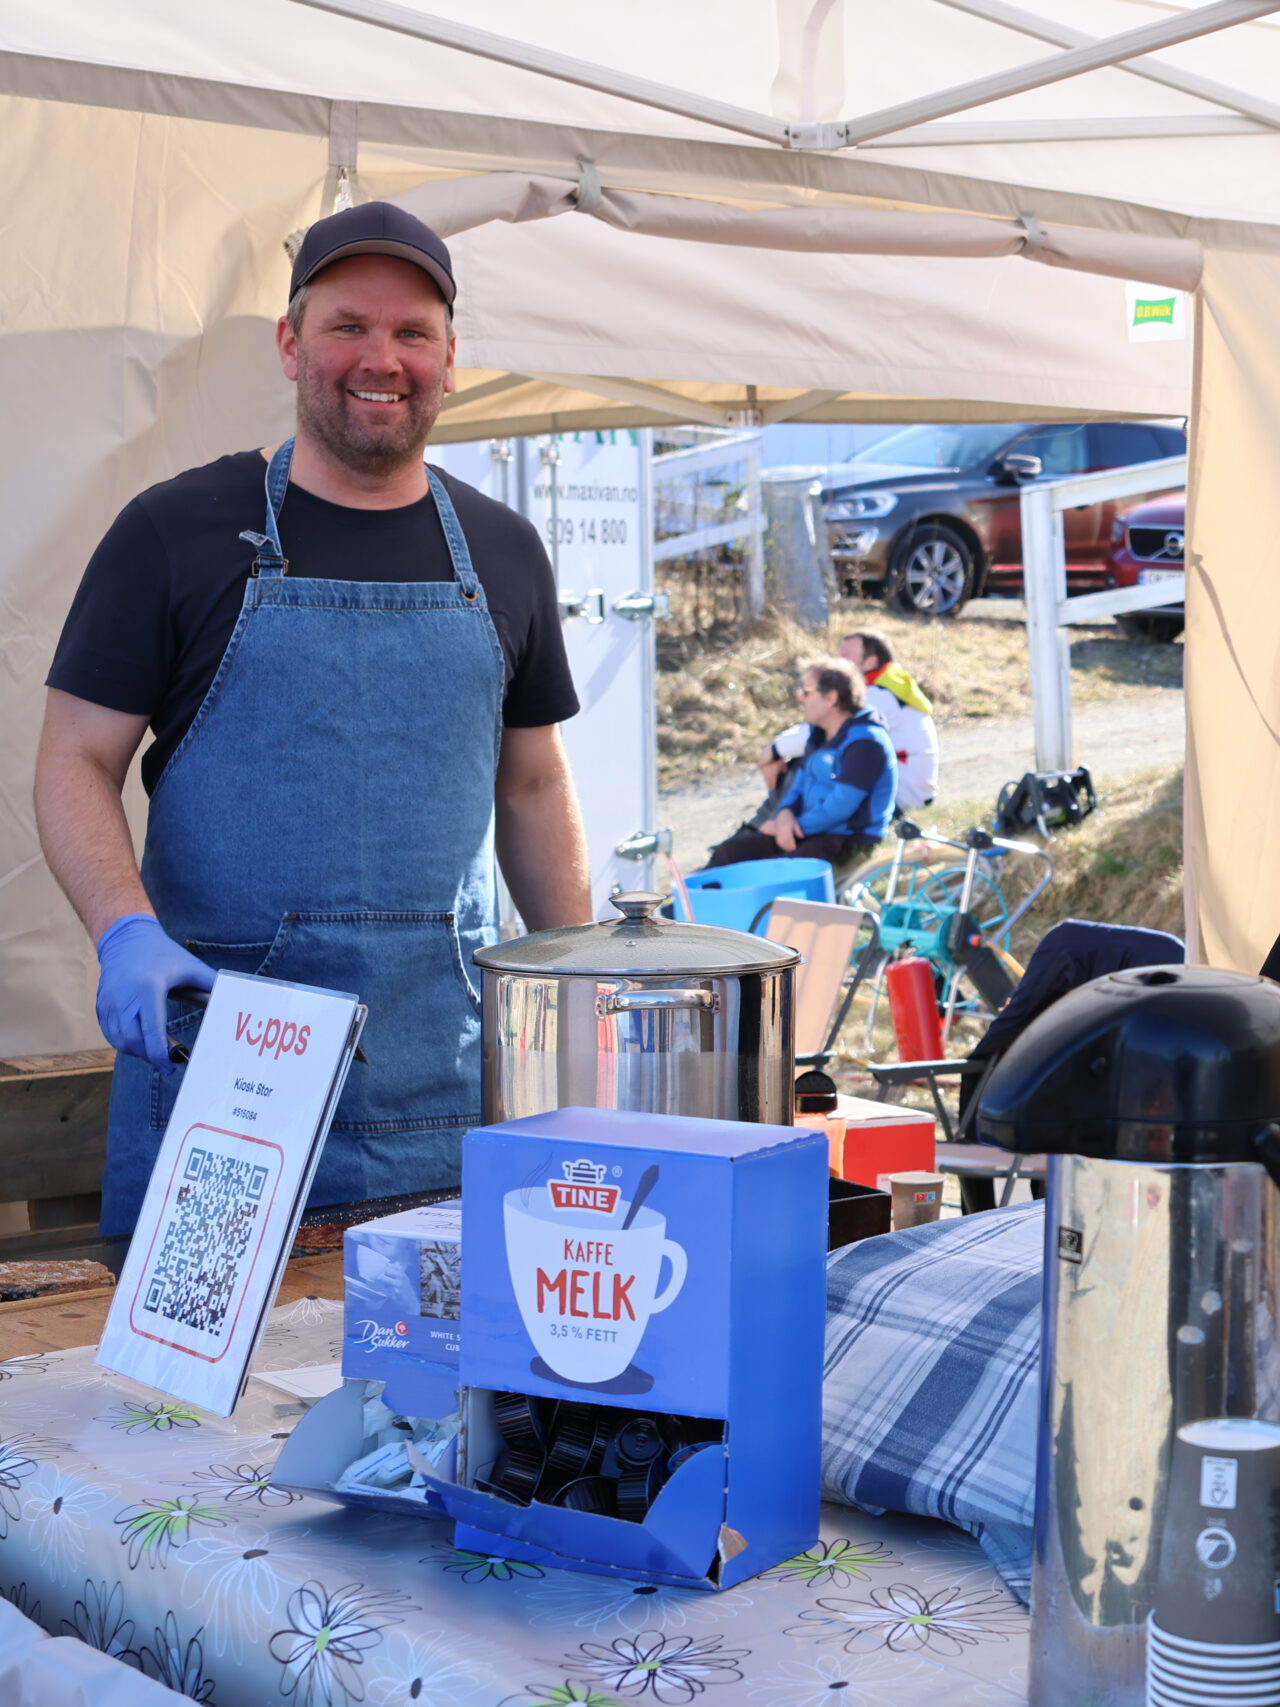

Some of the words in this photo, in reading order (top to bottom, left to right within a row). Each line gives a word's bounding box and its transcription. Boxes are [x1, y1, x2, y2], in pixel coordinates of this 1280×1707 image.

[579, 518, 597, 545] 14
[601, 518, 628, 545] 800
[233, 1077, 256, 1094] Kiosk
[256, 1082, 274, 1098] Stor
[557, 1186, 610, 1208] TINE
[564, 1238, 614, 1266] KAFFE
[536, 1267, 636, 1322] MELK
[353, 1319, 395, 1344] Dan
[430, 1330, 454, 1341] WHITE
[550, 1324, 568, 1338] 3,5
[586, 1328, 619, 1343] FETT
[364, 1335, 410, 1353] Sukker
